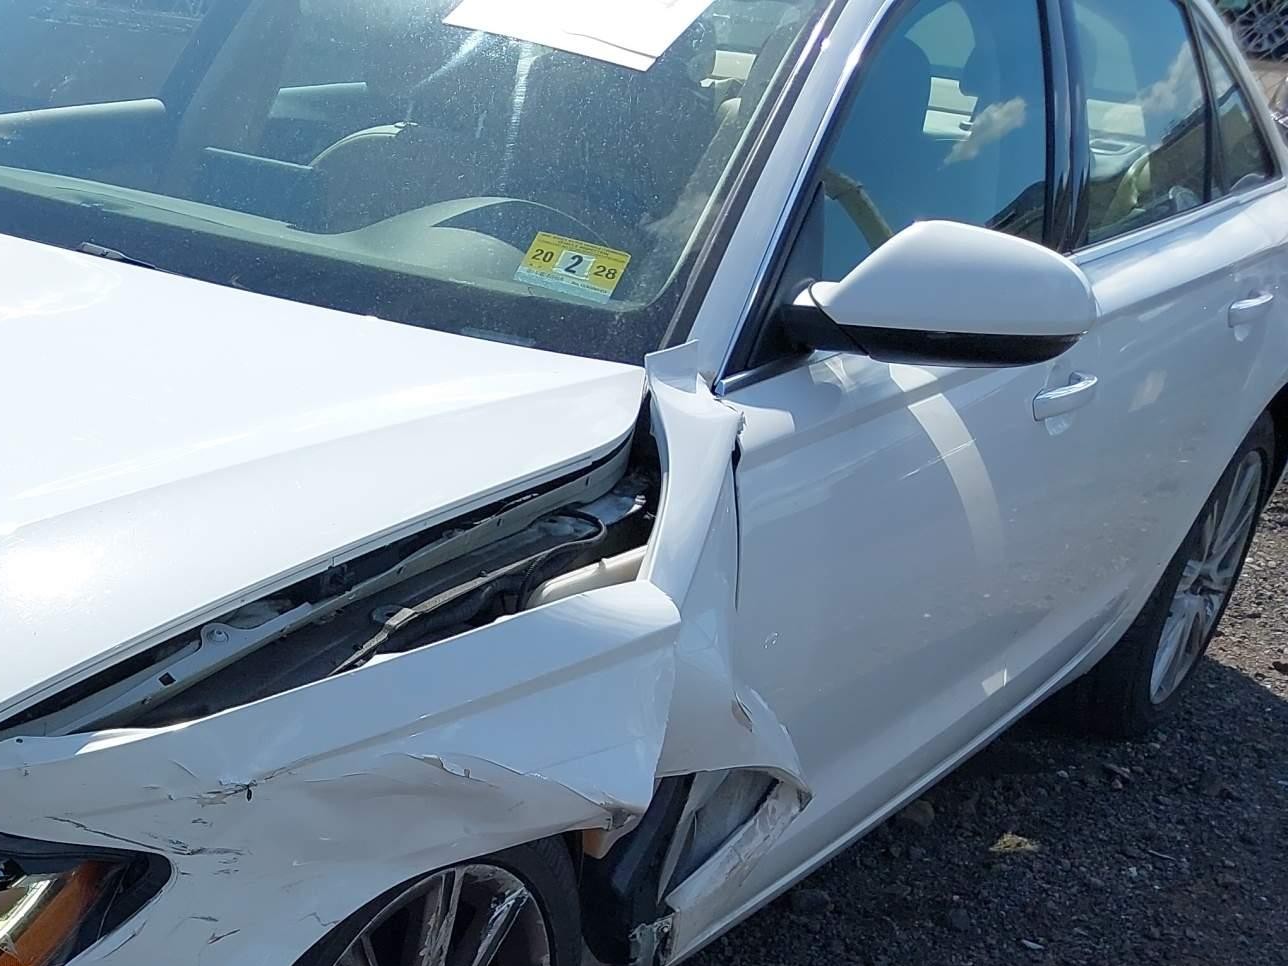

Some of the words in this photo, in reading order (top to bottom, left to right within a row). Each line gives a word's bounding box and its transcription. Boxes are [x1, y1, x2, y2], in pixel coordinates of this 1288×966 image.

[531, 248, 554, 263] 20
[564, 254, 584, 274] 2
[593, 265, 618, 280] 28
